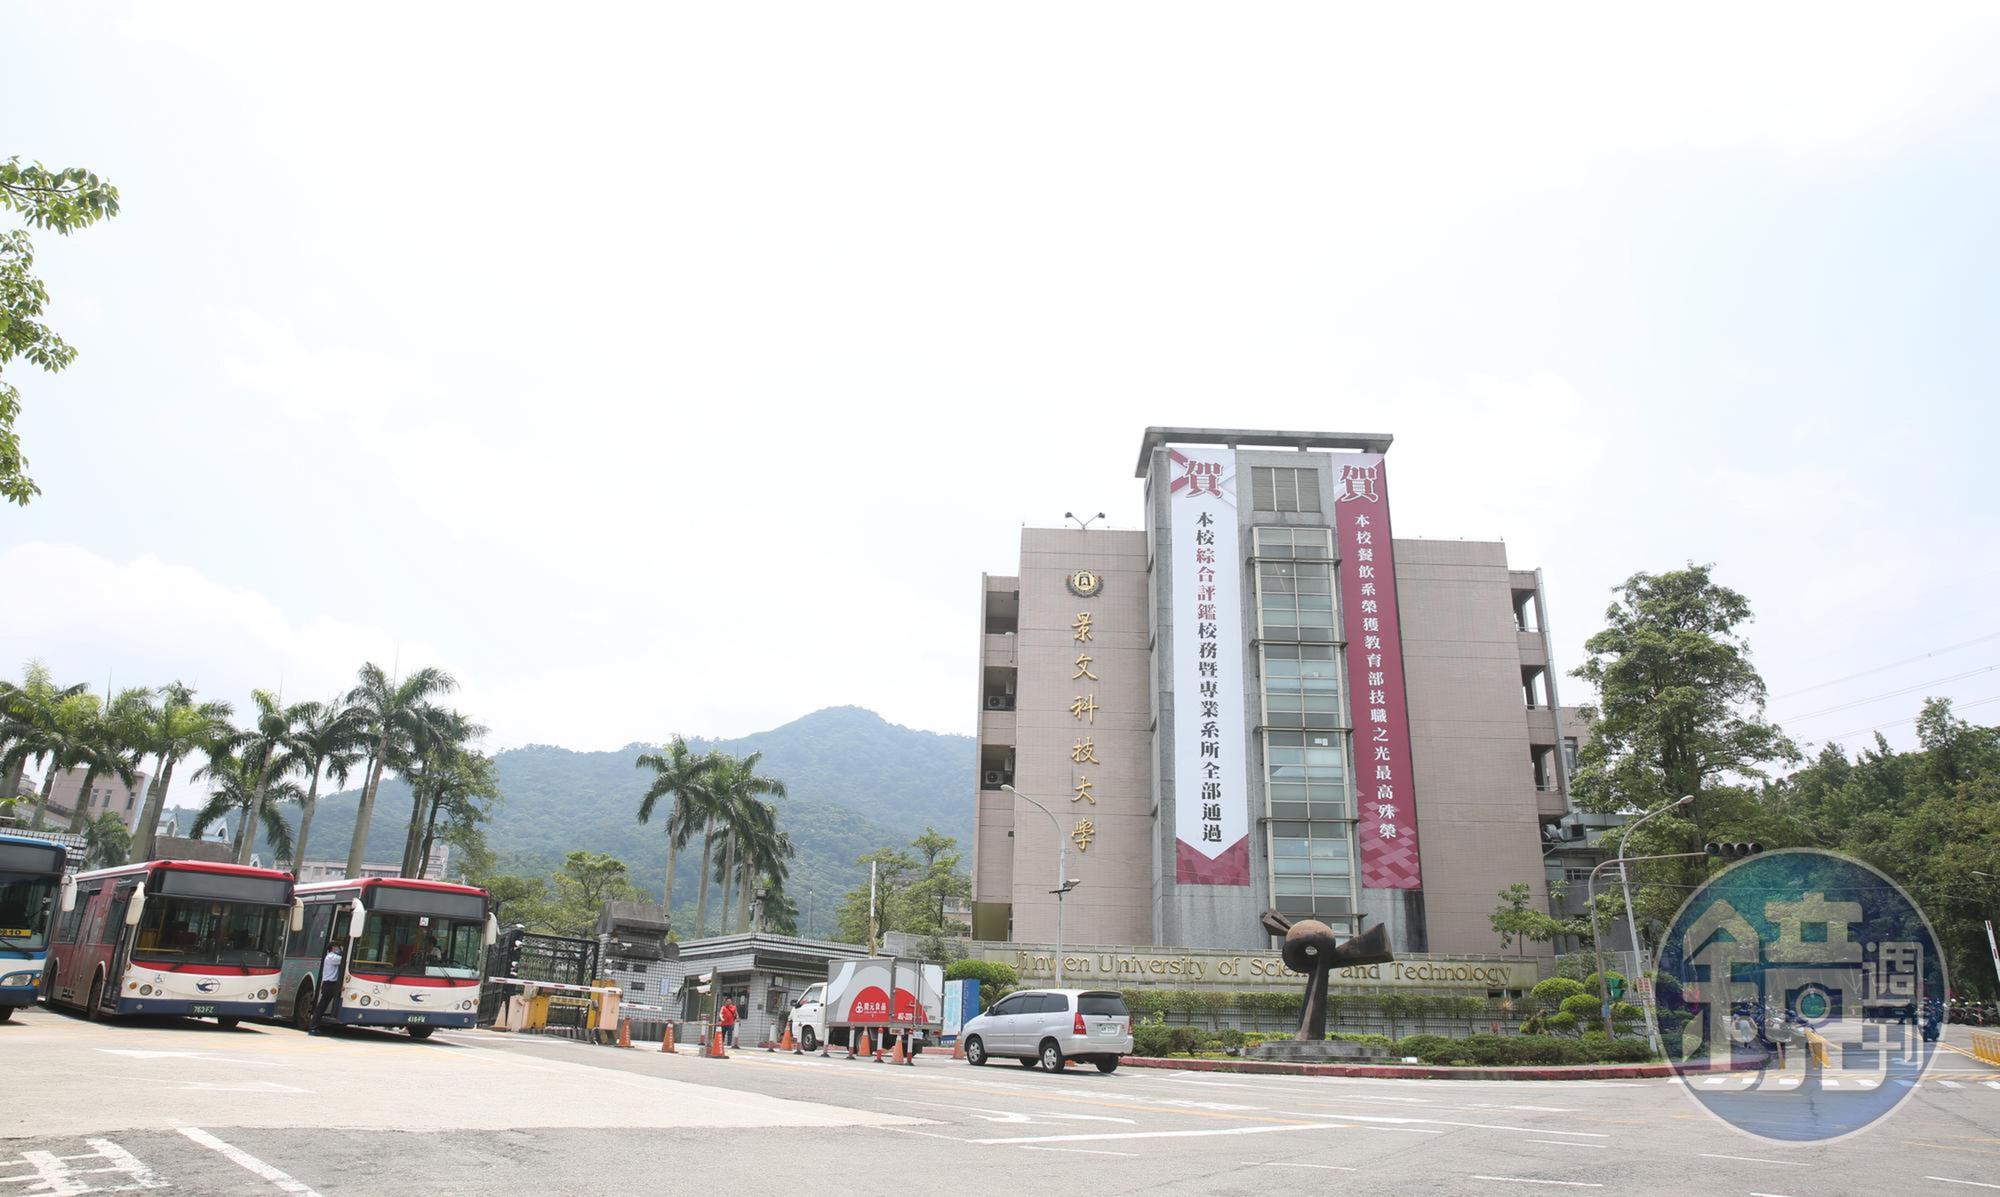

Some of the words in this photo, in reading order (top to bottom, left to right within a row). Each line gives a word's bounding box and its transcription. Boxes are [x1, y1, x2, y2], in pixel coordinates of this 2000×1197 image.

[1184, 459, 1225, 500] 賀
[1339, 464, 1379, 503] 賀
[1069, 611, 1100, 852] 景文科技大學
[1195, 511, 1222, 843] 本校綜合評鑑校務暨專業系所全部通過
[1354, 513, 1397, 840] 本校餐飲系榮獲教育部技職之光最高殊榮
[1098, 953, 1208, 980] University
[1218, 957, 1241, 976] of
[1250, 958, 1330, 978] Scie
[1340, 963, 1381, 980] and
[1392, 961, 1512, 987] Technology
